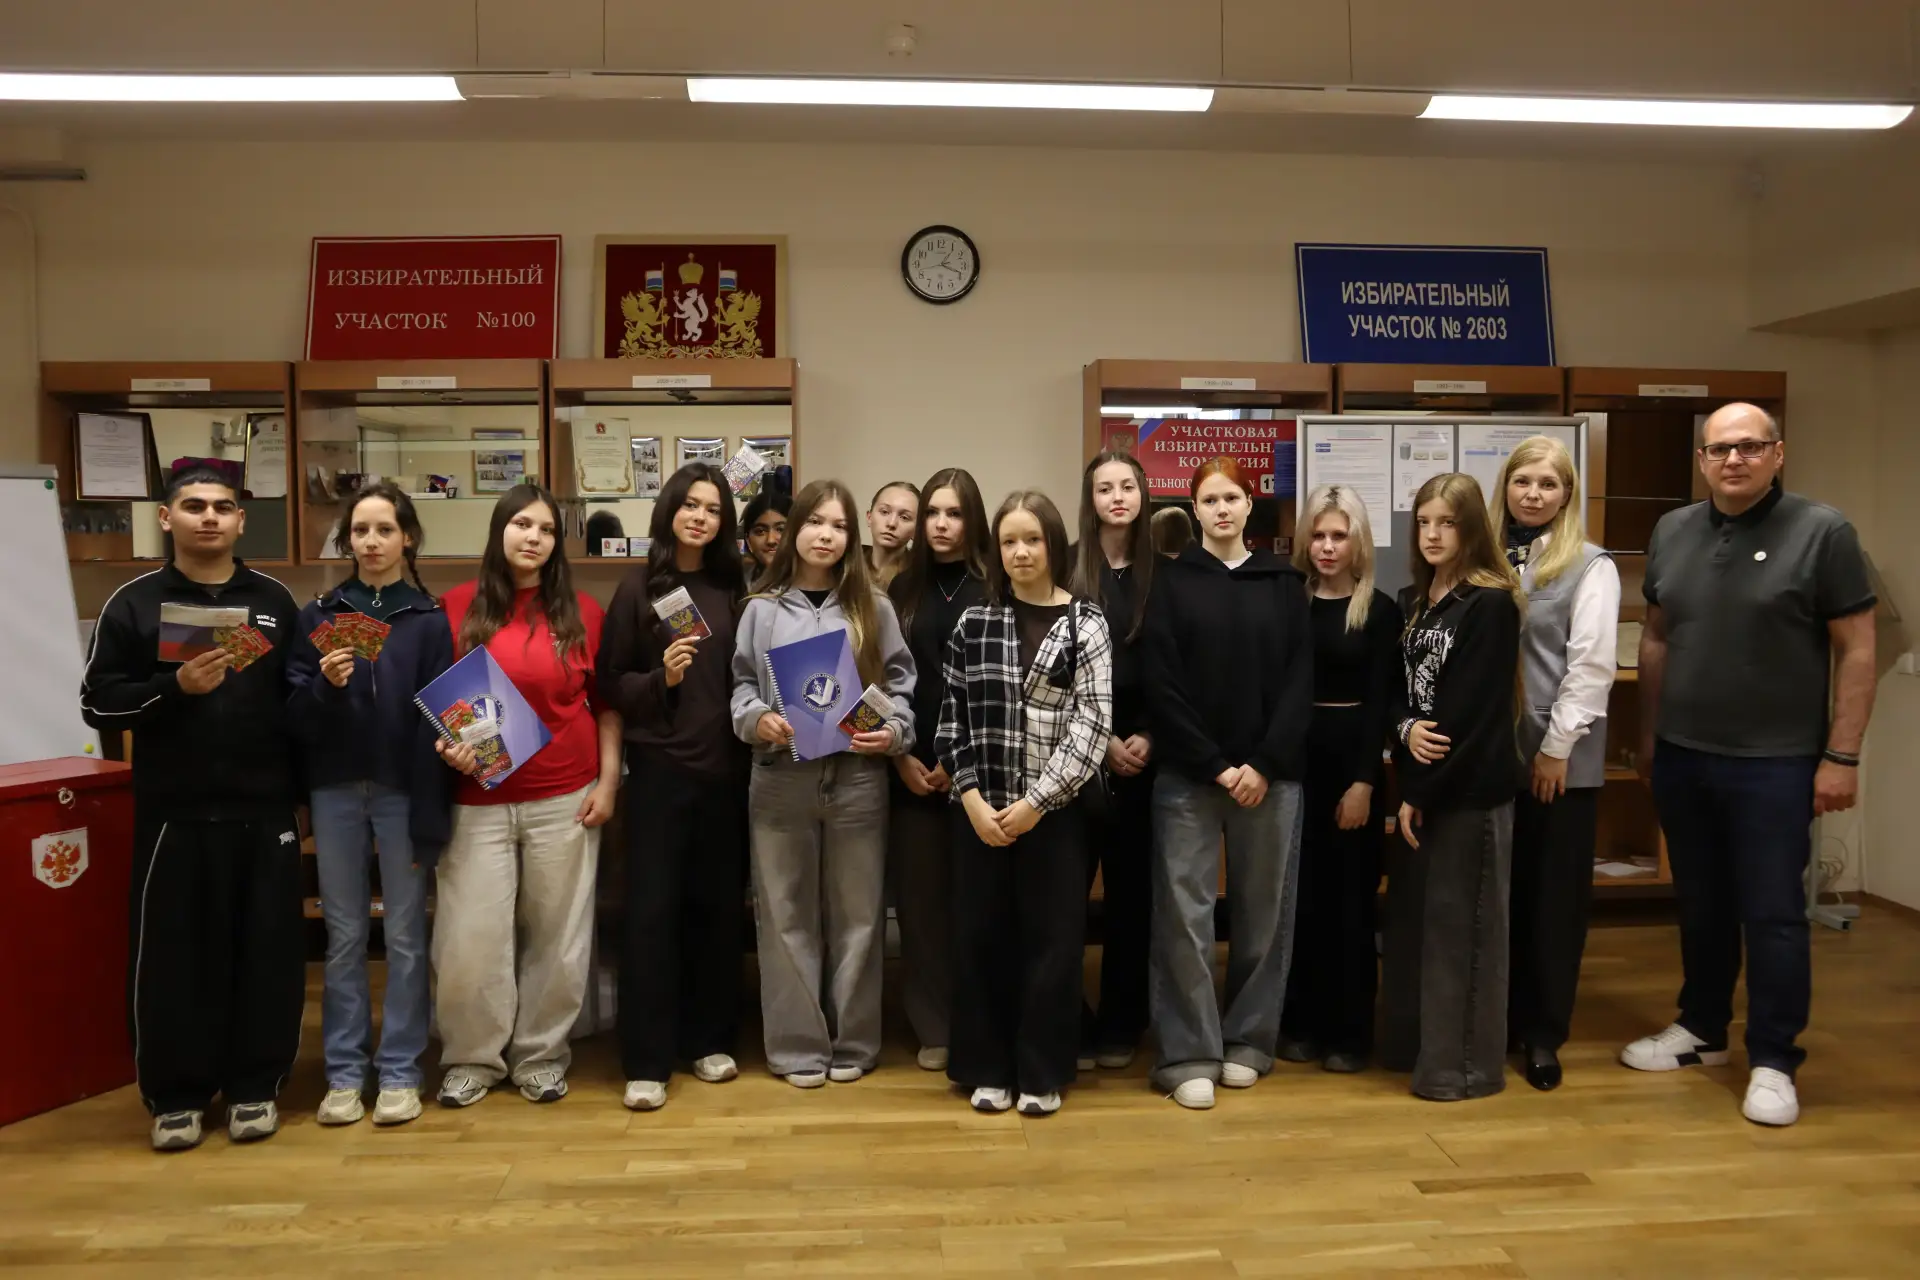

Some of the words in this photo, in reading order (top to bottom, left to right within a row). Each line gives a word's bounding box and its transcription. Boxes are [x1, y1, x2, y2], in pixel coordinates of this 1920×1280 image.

[327, 264, 544, 286] ИЗБИРАТЕЛЬНЫЙ
[1341, 278, 1510, 307] ИЗБИРАТЕЛЬНЫЙ
[335, 312, 448, 329] УЧАСТОК
[476, 311, 536, 328] №100
[1348, 314, 1436, 339] УЧАСТОК
[1441, 316, 1461, 339] №
[1466, 317, 1508, 340] 2603
[1171, 425, 1278, 438] УЧАСТКОВАЯ
[1154, 440, 1275, 453] ИЗБИРАТЕЛЬН
[1178, 456, 1269, 469] КОСИЯ
